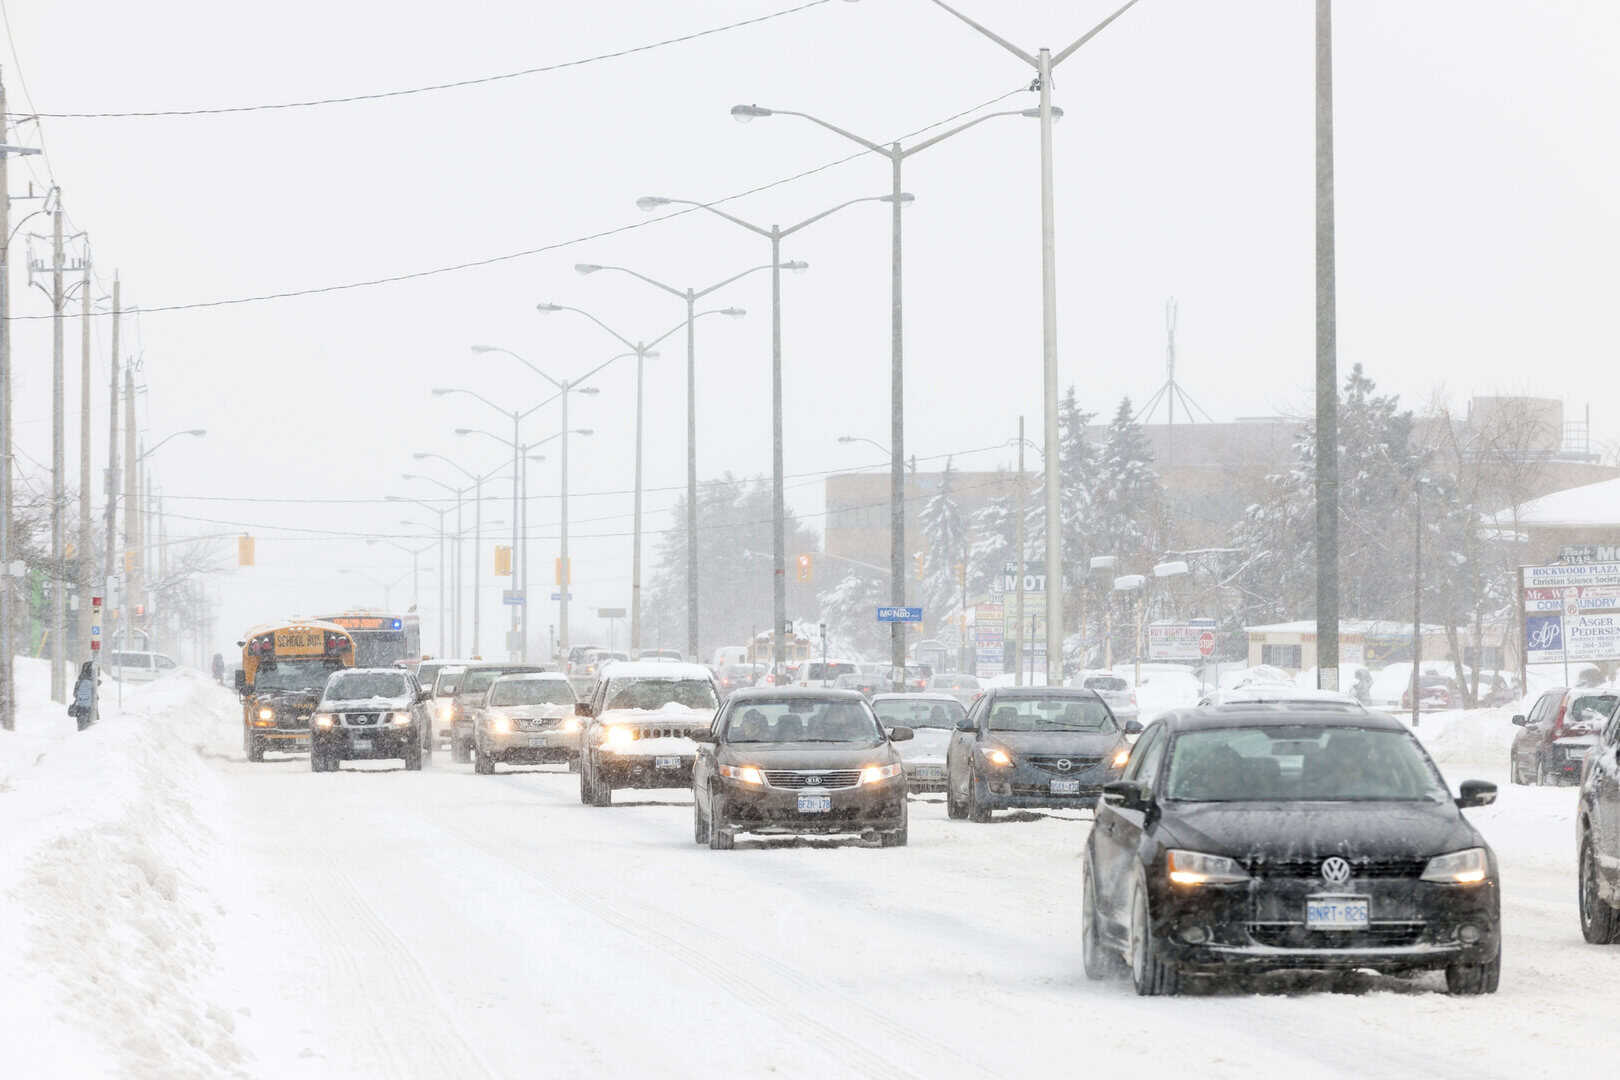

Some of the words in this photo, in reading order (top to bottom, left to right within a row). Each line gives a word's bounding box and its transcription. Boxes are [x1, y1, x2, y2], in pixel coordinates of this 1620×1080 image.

[1532, 566, 1586, 576] ROCKWOOD
[1589, 565, 1618, 574] PLAZA
[1532, 576, 1565, 586] Christian
[1566, 575, 1593, 585] Science
[1527, 590, 1545, 600] Mr.
[1578, 616, 1614, 627] ASGER
[277, 633, 305, 648] SCHOOL
[306, 633, 322, 648] BUS
[1200, 639, 1214, 649] STOP
